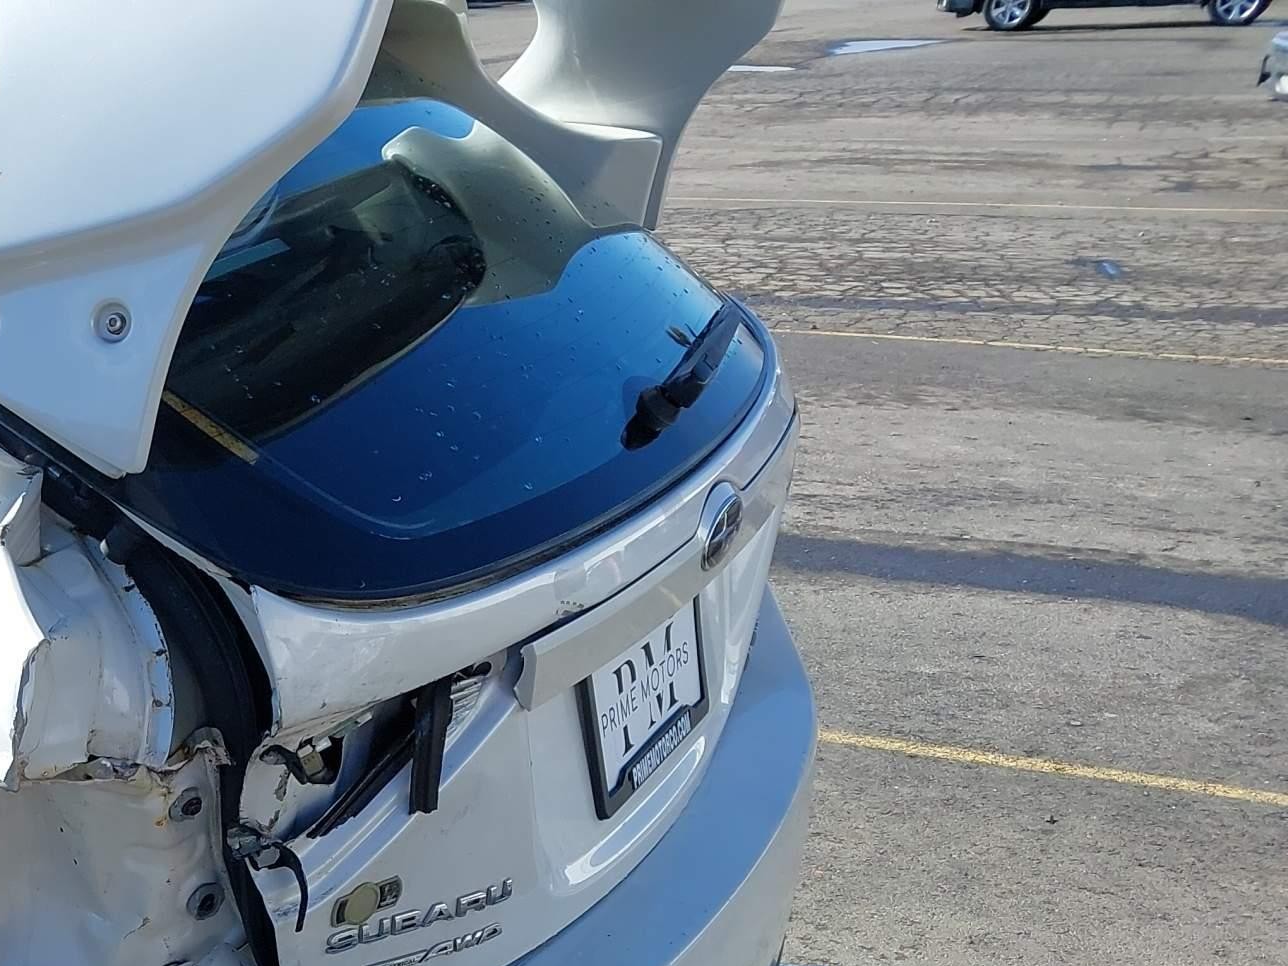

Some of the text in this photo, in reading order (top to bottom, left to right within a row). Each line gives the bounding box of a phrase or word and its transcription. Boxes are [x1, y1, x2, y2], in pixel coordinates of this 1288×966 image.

[601, 641, 689, 737] PRIME MOTORS
[631, 711, 692, 790] PRIMEMOTORCO.COM
[325, 877, 513, 954] SUBARU
[419, 921, 503, 964] AWD
